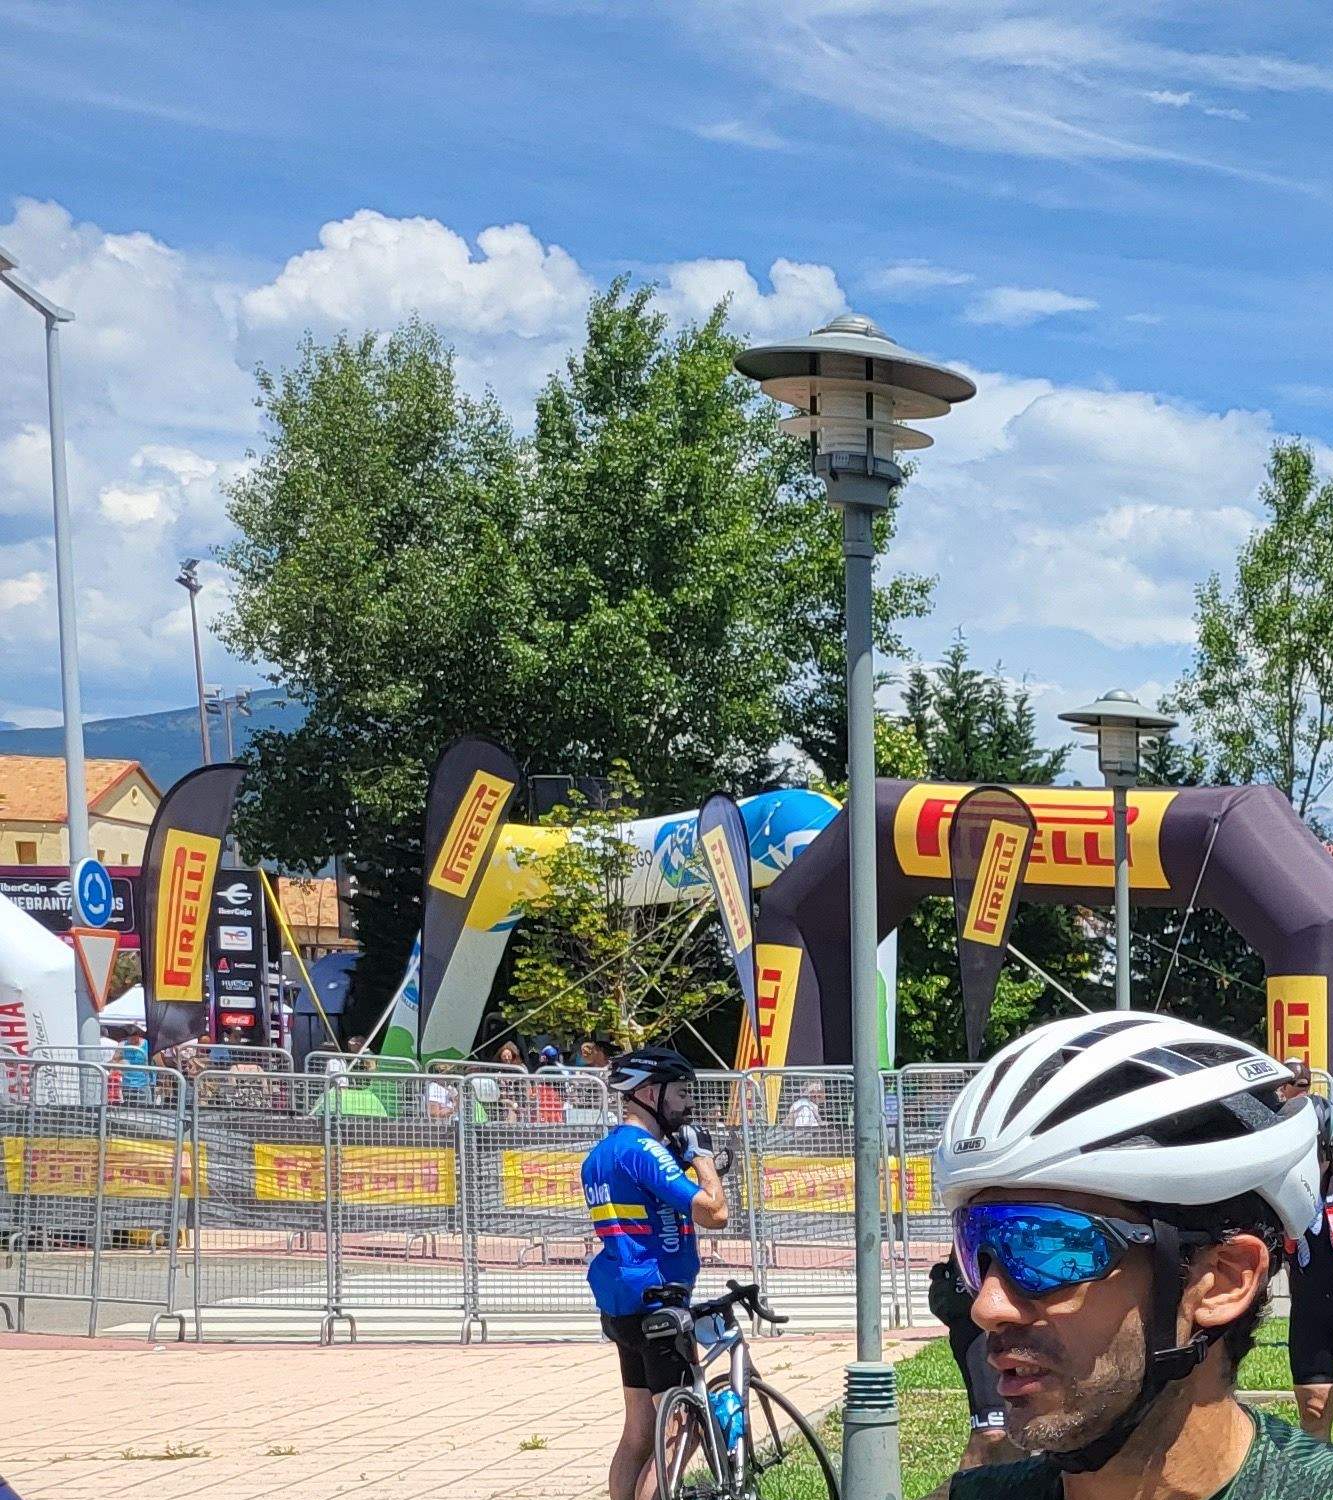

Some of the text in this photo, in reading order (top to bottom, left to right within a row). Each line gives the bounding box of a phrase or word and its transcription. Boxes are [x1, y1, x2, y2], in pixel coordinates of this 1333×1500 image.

[440, 784, 501, 885] PIRELLI
[916, 798, 1139, 868] PELLI
[163, 846, 208, 987] PIRELLI
[974, 832, 1018, 935] PIRELLI
[1245, 1061, 1274, 1079] ABUS
[957, 1139, 982, 1152] ABUS
